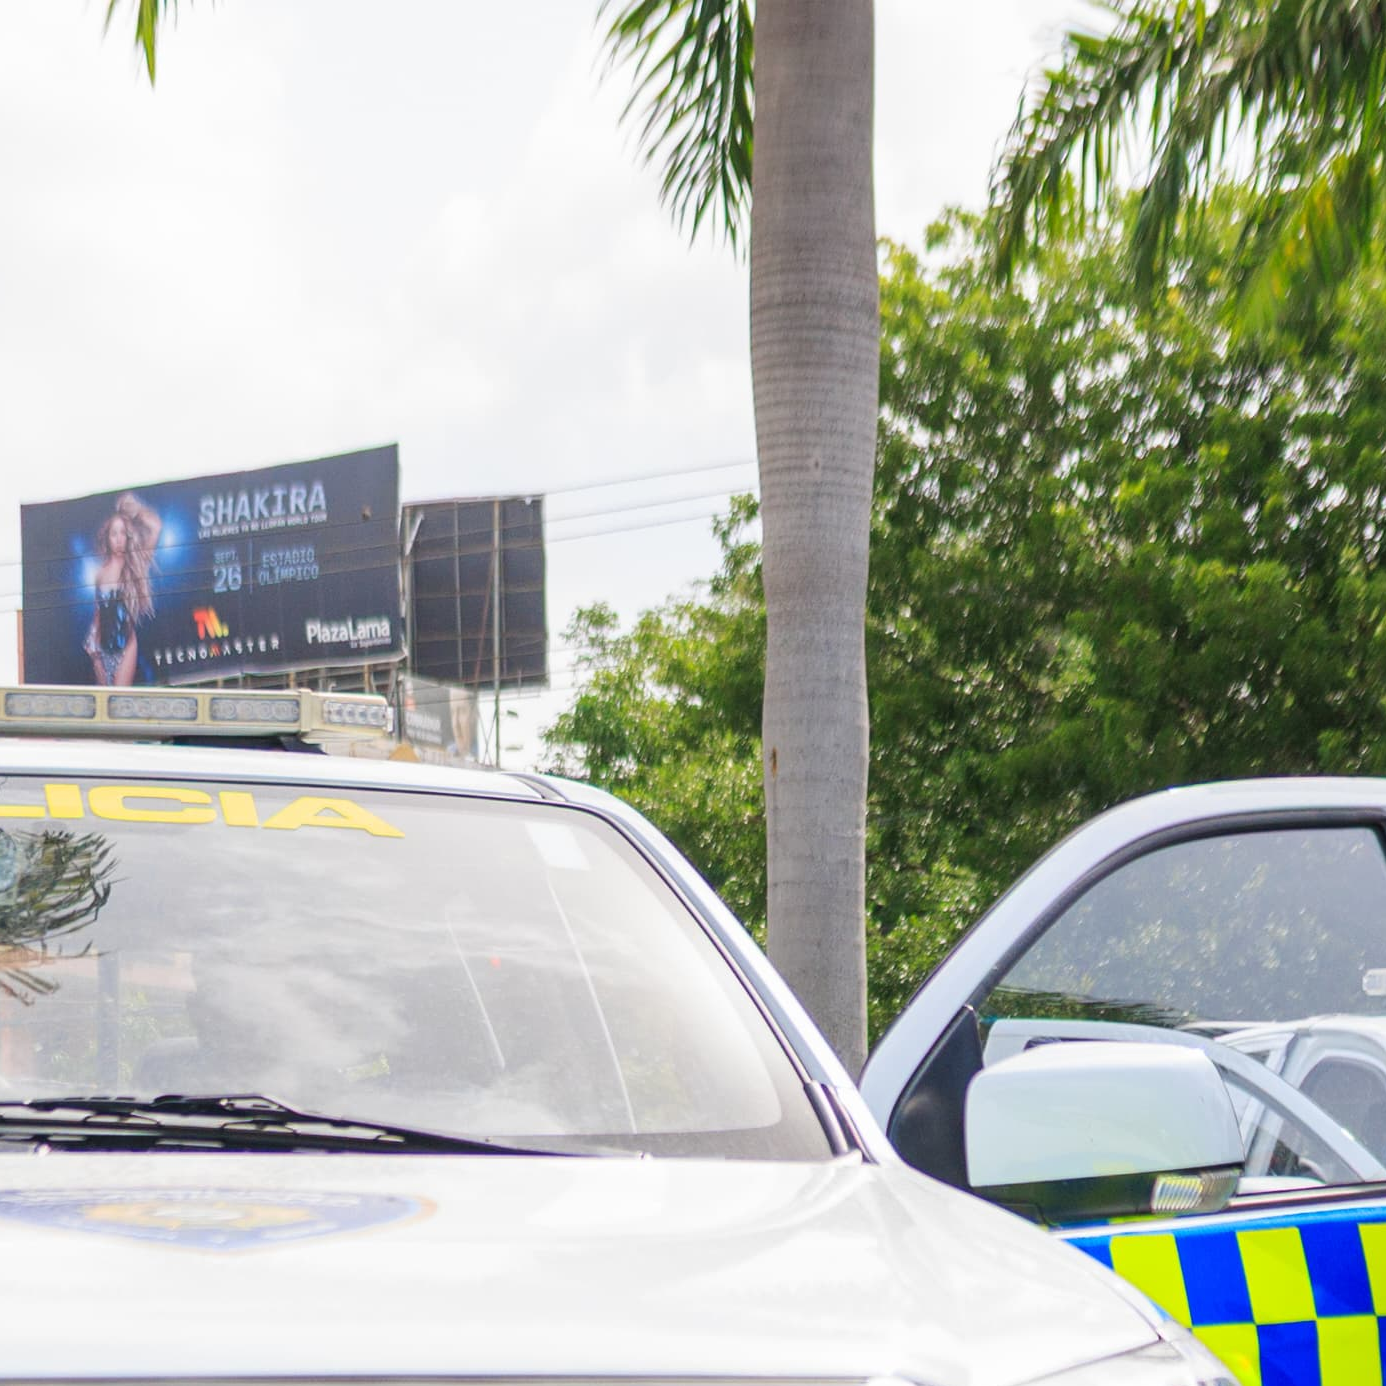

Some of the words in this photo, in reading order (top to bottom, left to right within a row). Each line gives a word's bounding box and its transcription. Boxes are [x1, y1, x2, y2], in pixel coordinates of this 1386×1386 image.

[199, 482, 327, 527] SHAKIRA
[262, 548, 315, 568] ESTADIO
[213, 565, 242, 593] 26
[306, 617, 391, 644] PlazaLama
[154, 633, 280, 666] TECNOMASTER
